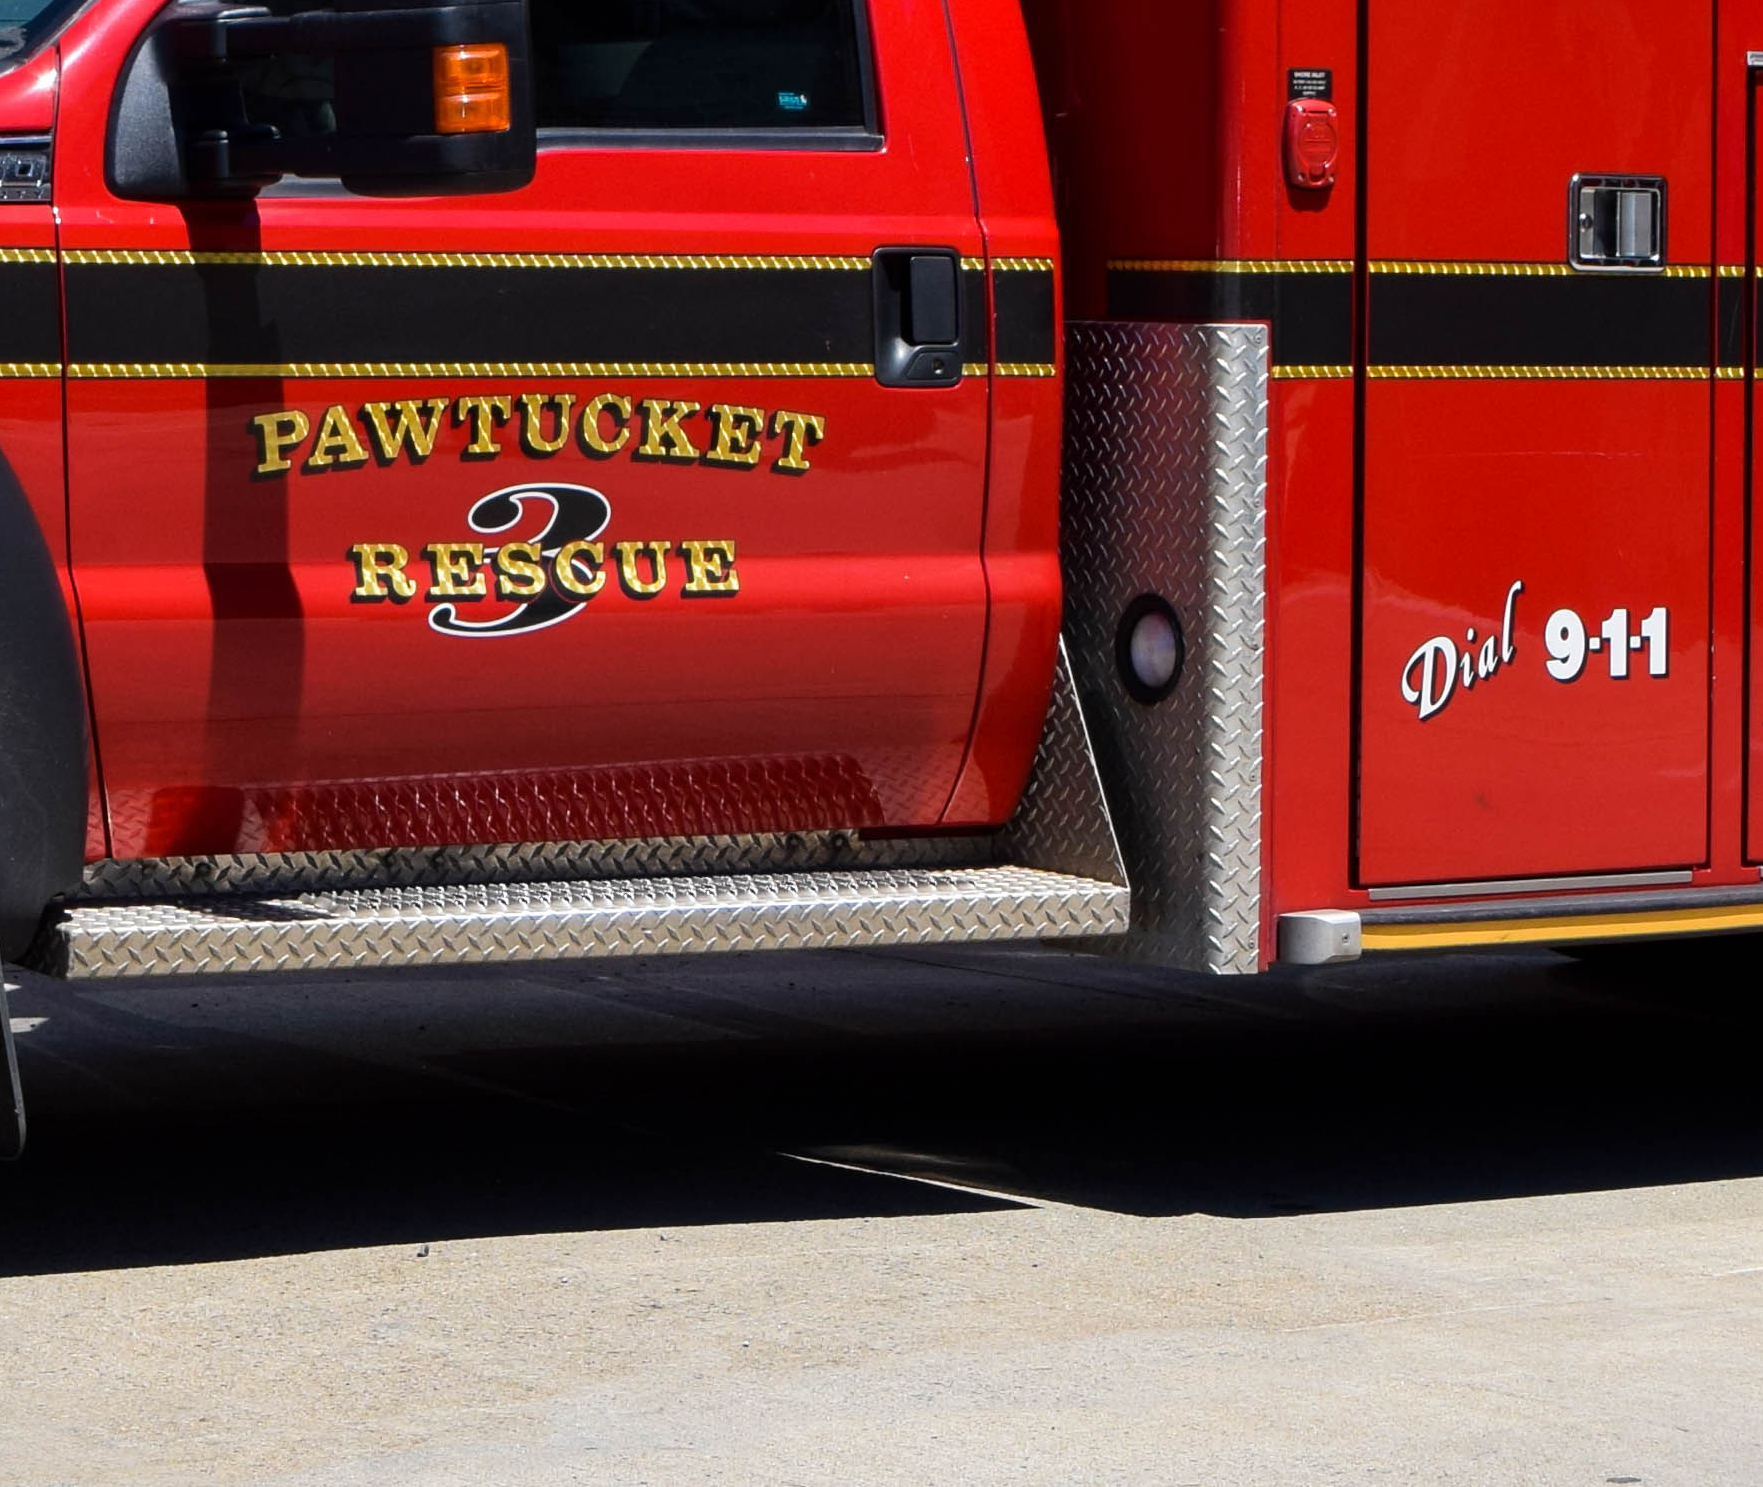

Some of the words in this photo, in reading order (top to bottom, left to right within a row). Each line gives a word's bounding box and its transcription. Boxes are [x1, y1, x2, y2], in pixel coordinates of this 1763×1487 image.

[249, 392, 826, 479] PAWTUCKET
[348, 539, 740, 603] RESCUE
[428, 482, 612, 638] 3
[1401, 579, 1525, 721] Dial
[1544, 606, 1669, 683] 9-1-1
